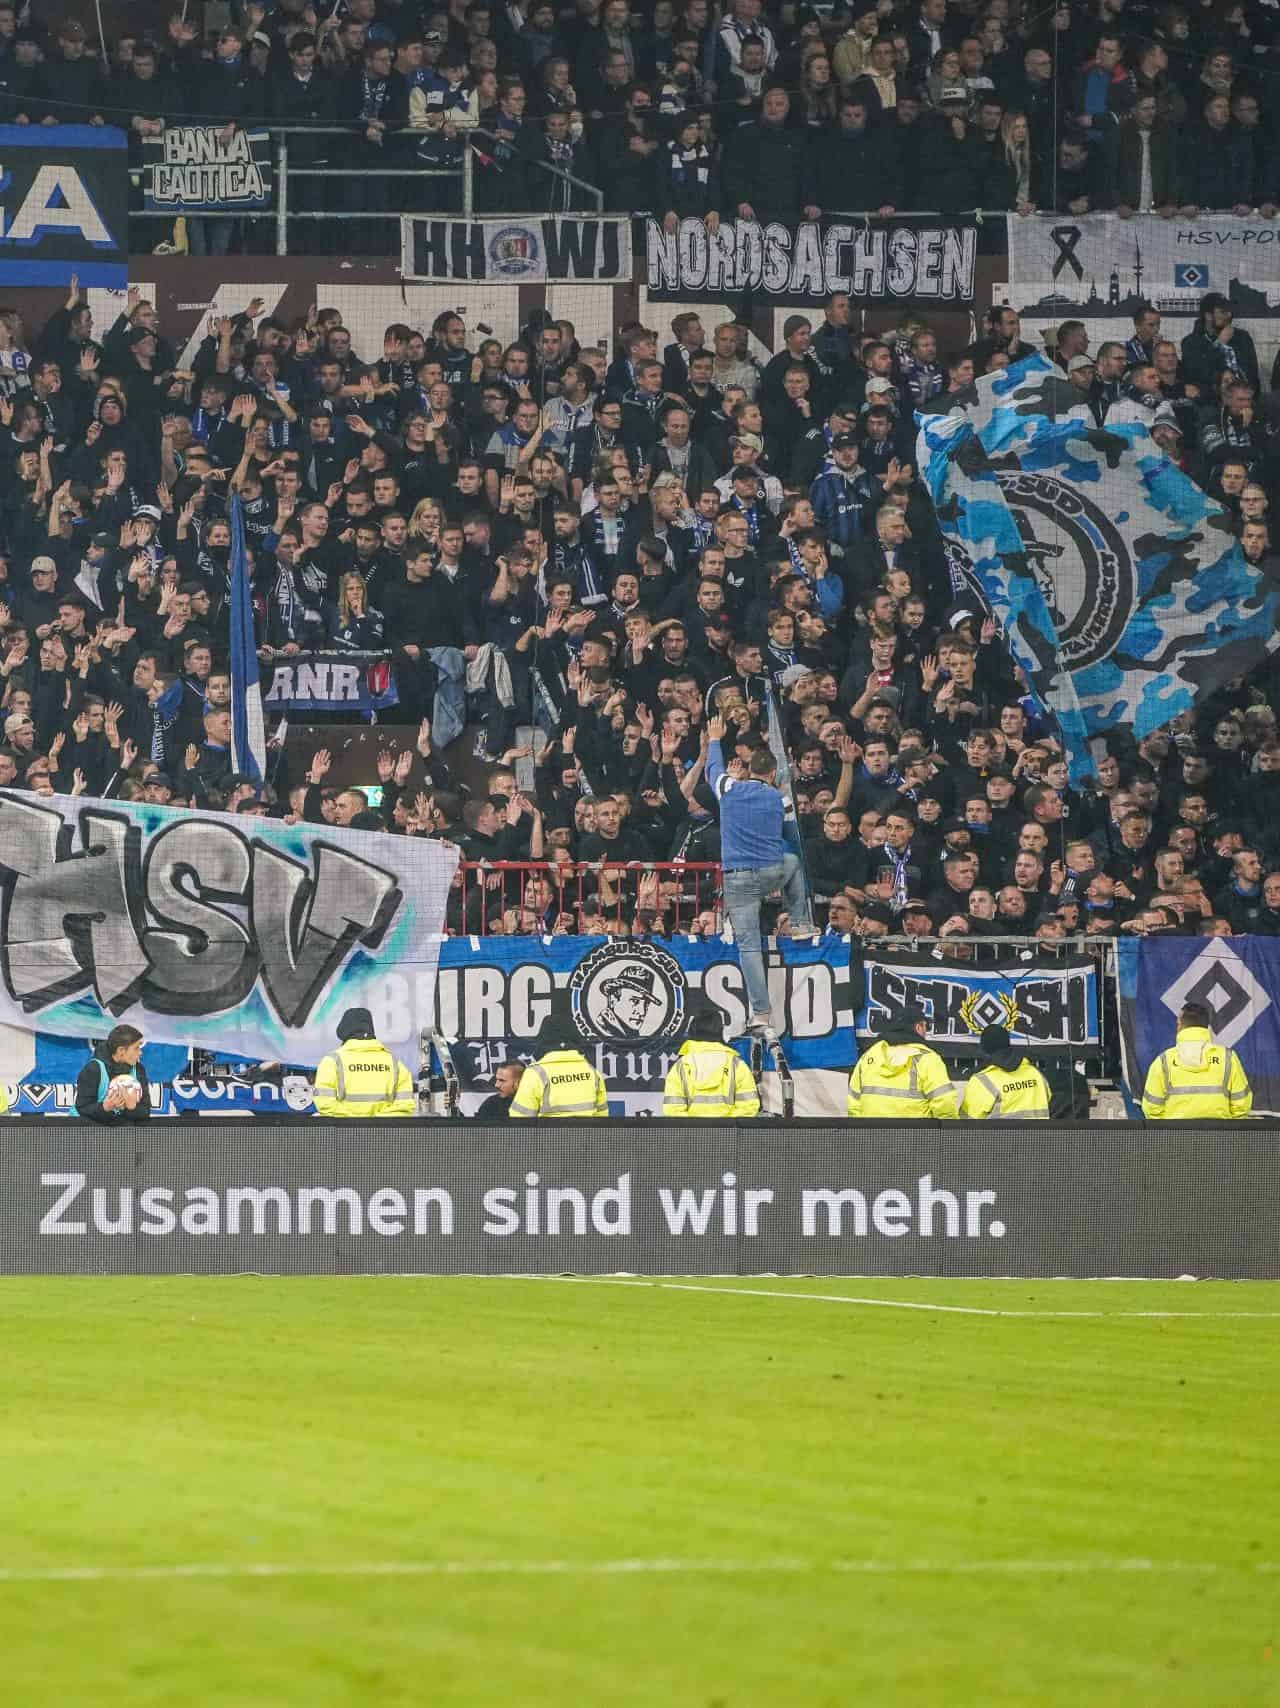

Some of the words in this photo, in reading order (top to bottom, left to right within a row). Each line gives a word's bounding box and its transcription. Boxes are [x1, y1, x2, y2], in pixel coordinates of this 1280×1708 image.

[1176, 229, 1280, 246] HSV-PO
[412, 219, 487, 280] HH
[540, 219, 620, 280] WJ
[646, 215, 977, 300] NORDSACHSEN
[347, 1062, 391, 1074] ORDNER
[550, 1071, 591, 1086] ORDNER
[1001, 1077, 1039, 1095] ORDNER
[39, 1173, 454, 1236] Zusammen
[483, 1172, 632, 1236] sind
[658, 1171, 775, 1237] wir
[802, 1173, 1007, 1238] mehr.
